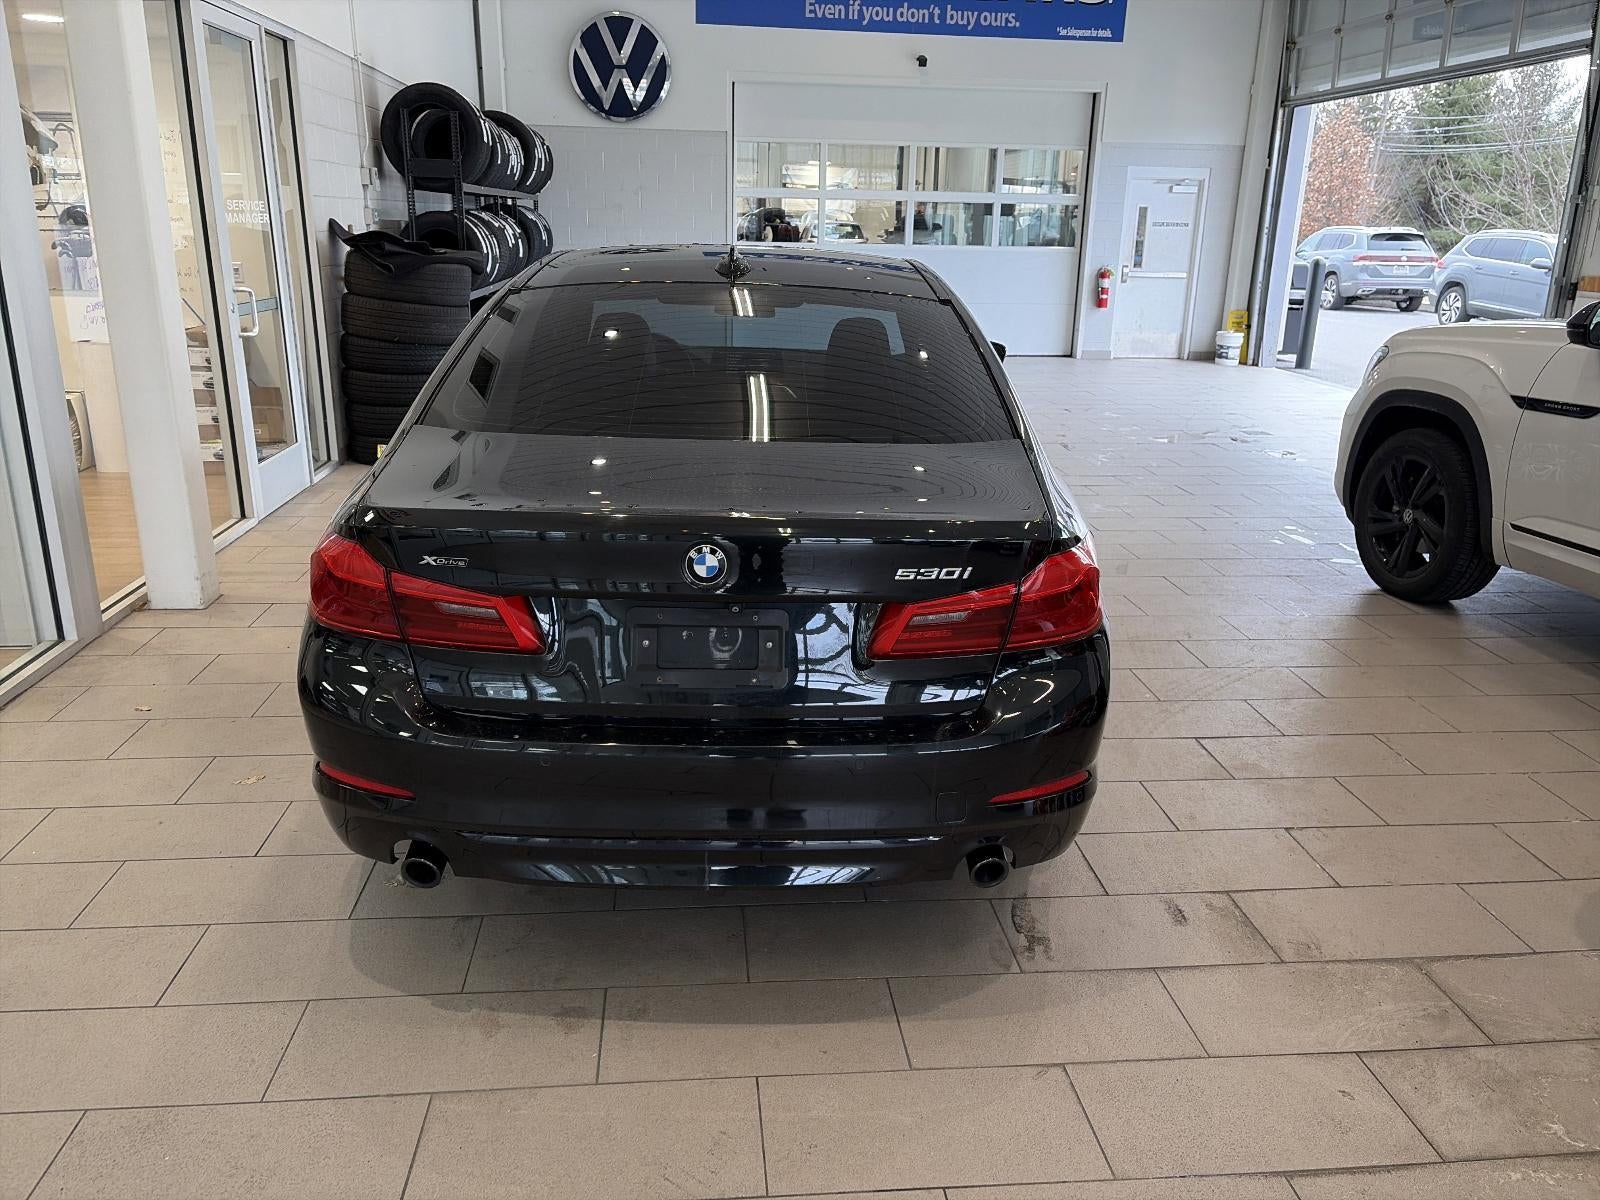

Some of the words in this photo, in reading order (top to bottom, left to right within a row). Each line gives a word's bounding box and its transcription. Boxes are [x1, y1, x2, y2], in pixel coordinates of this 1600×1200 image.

[805, 1, 845, 19] Even
[850, 2, 860, 20] if
[862, 6, 893, 25] you
[946, 5, 977, 30] buy
[980, 12, 1020, 28] ours.
[226, 199, 266, 211] SERVICE
[224, 211, 270, 225] MANAGER
[689, 546, 724, 560] BMW
[894, 566, 973, 580] 530i
